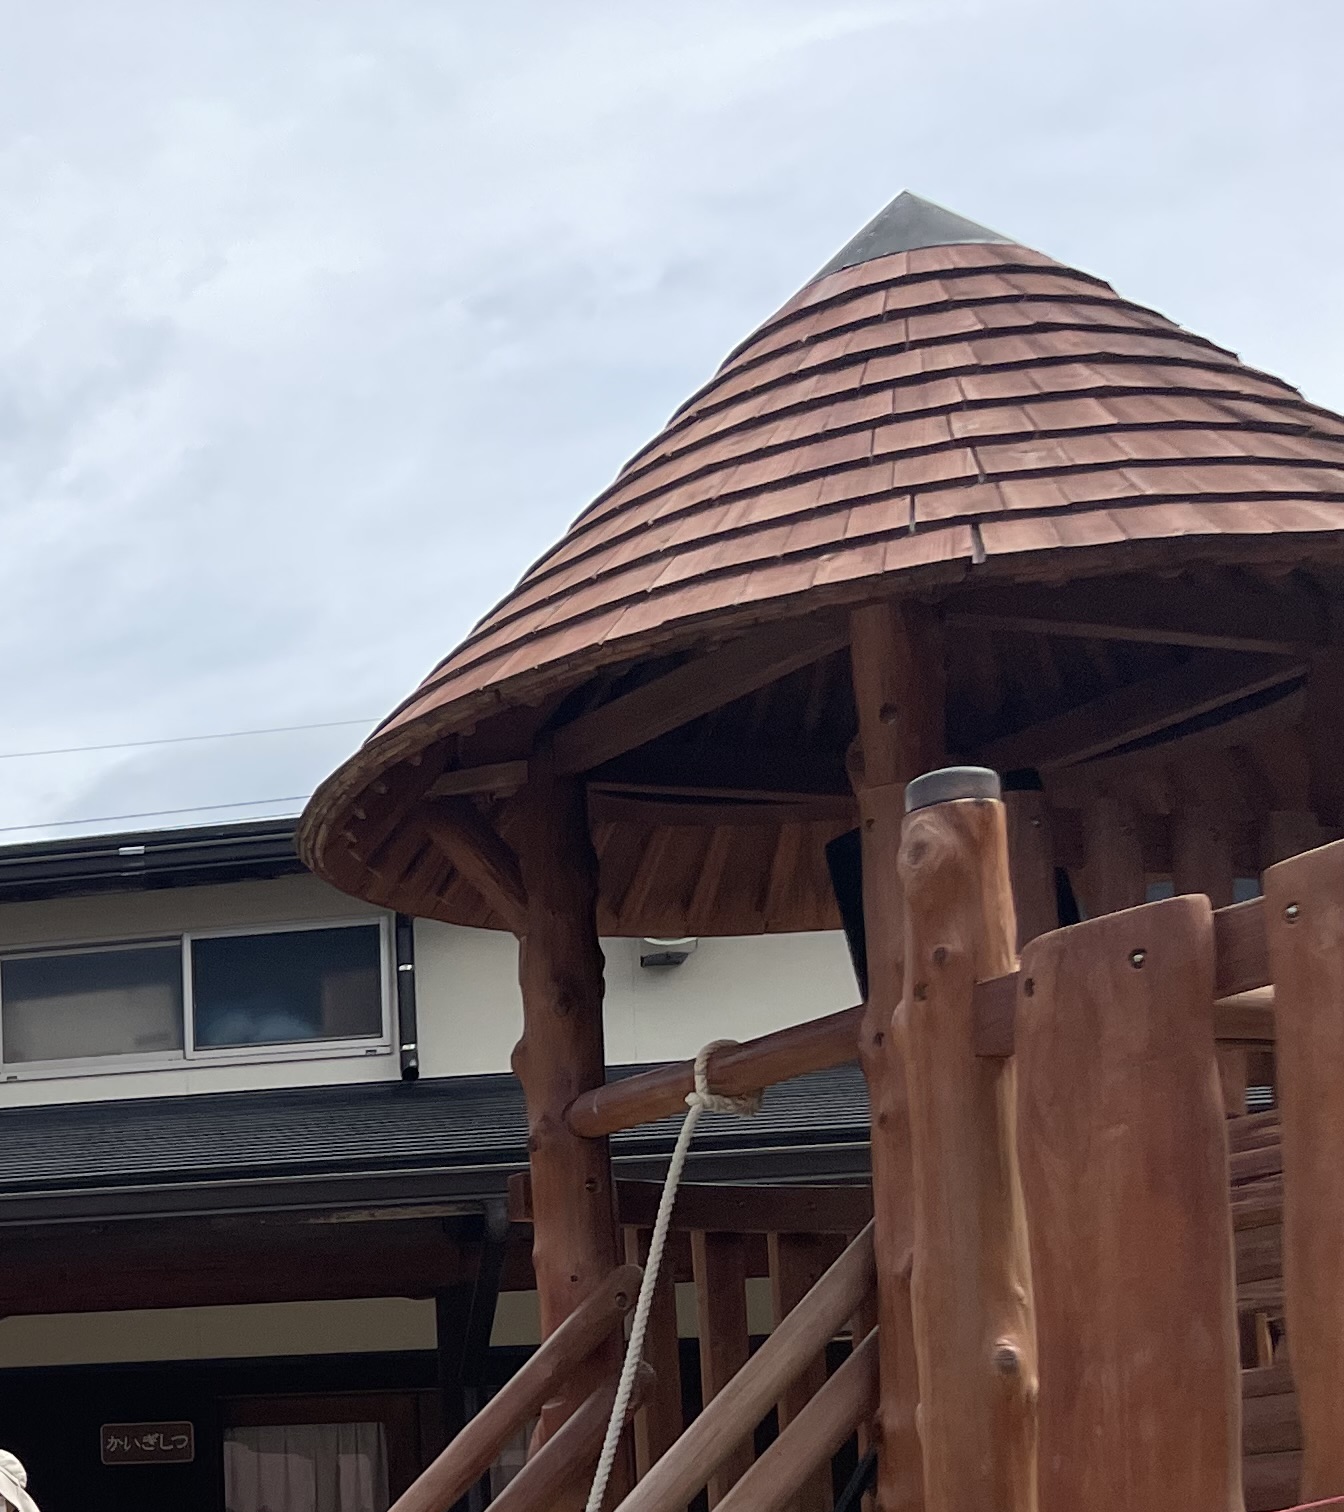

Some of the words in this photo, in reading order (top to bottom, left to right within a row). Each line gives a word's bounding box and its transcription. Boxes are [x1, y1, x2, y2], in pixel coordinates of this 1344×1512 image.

[106, 1432, 189, 1452] かいぎしつ
